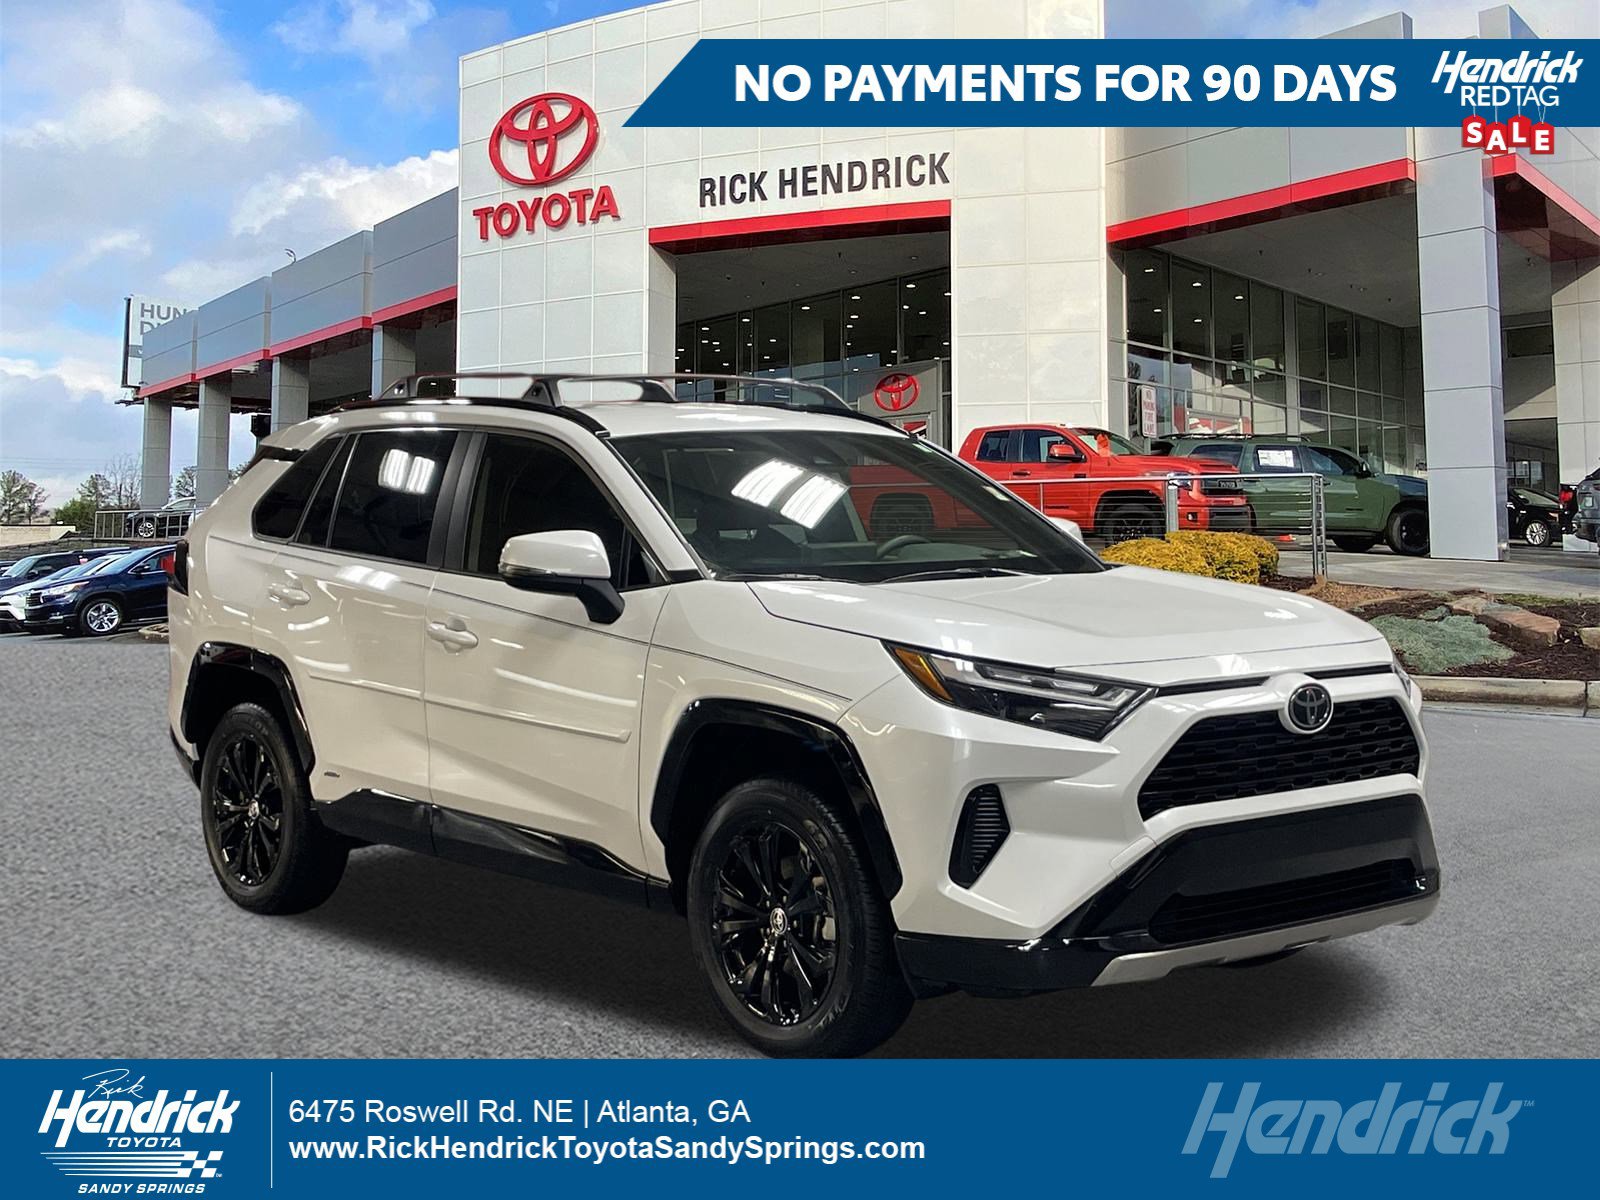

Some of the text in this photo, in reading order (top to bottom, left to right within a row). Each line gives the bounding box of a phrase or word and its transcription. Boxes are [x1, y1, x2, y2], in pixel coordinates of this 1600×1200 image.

[699, 152, 950, 208] RICK HENDRICK
[473, 185, 620, 240] TOYOTA
